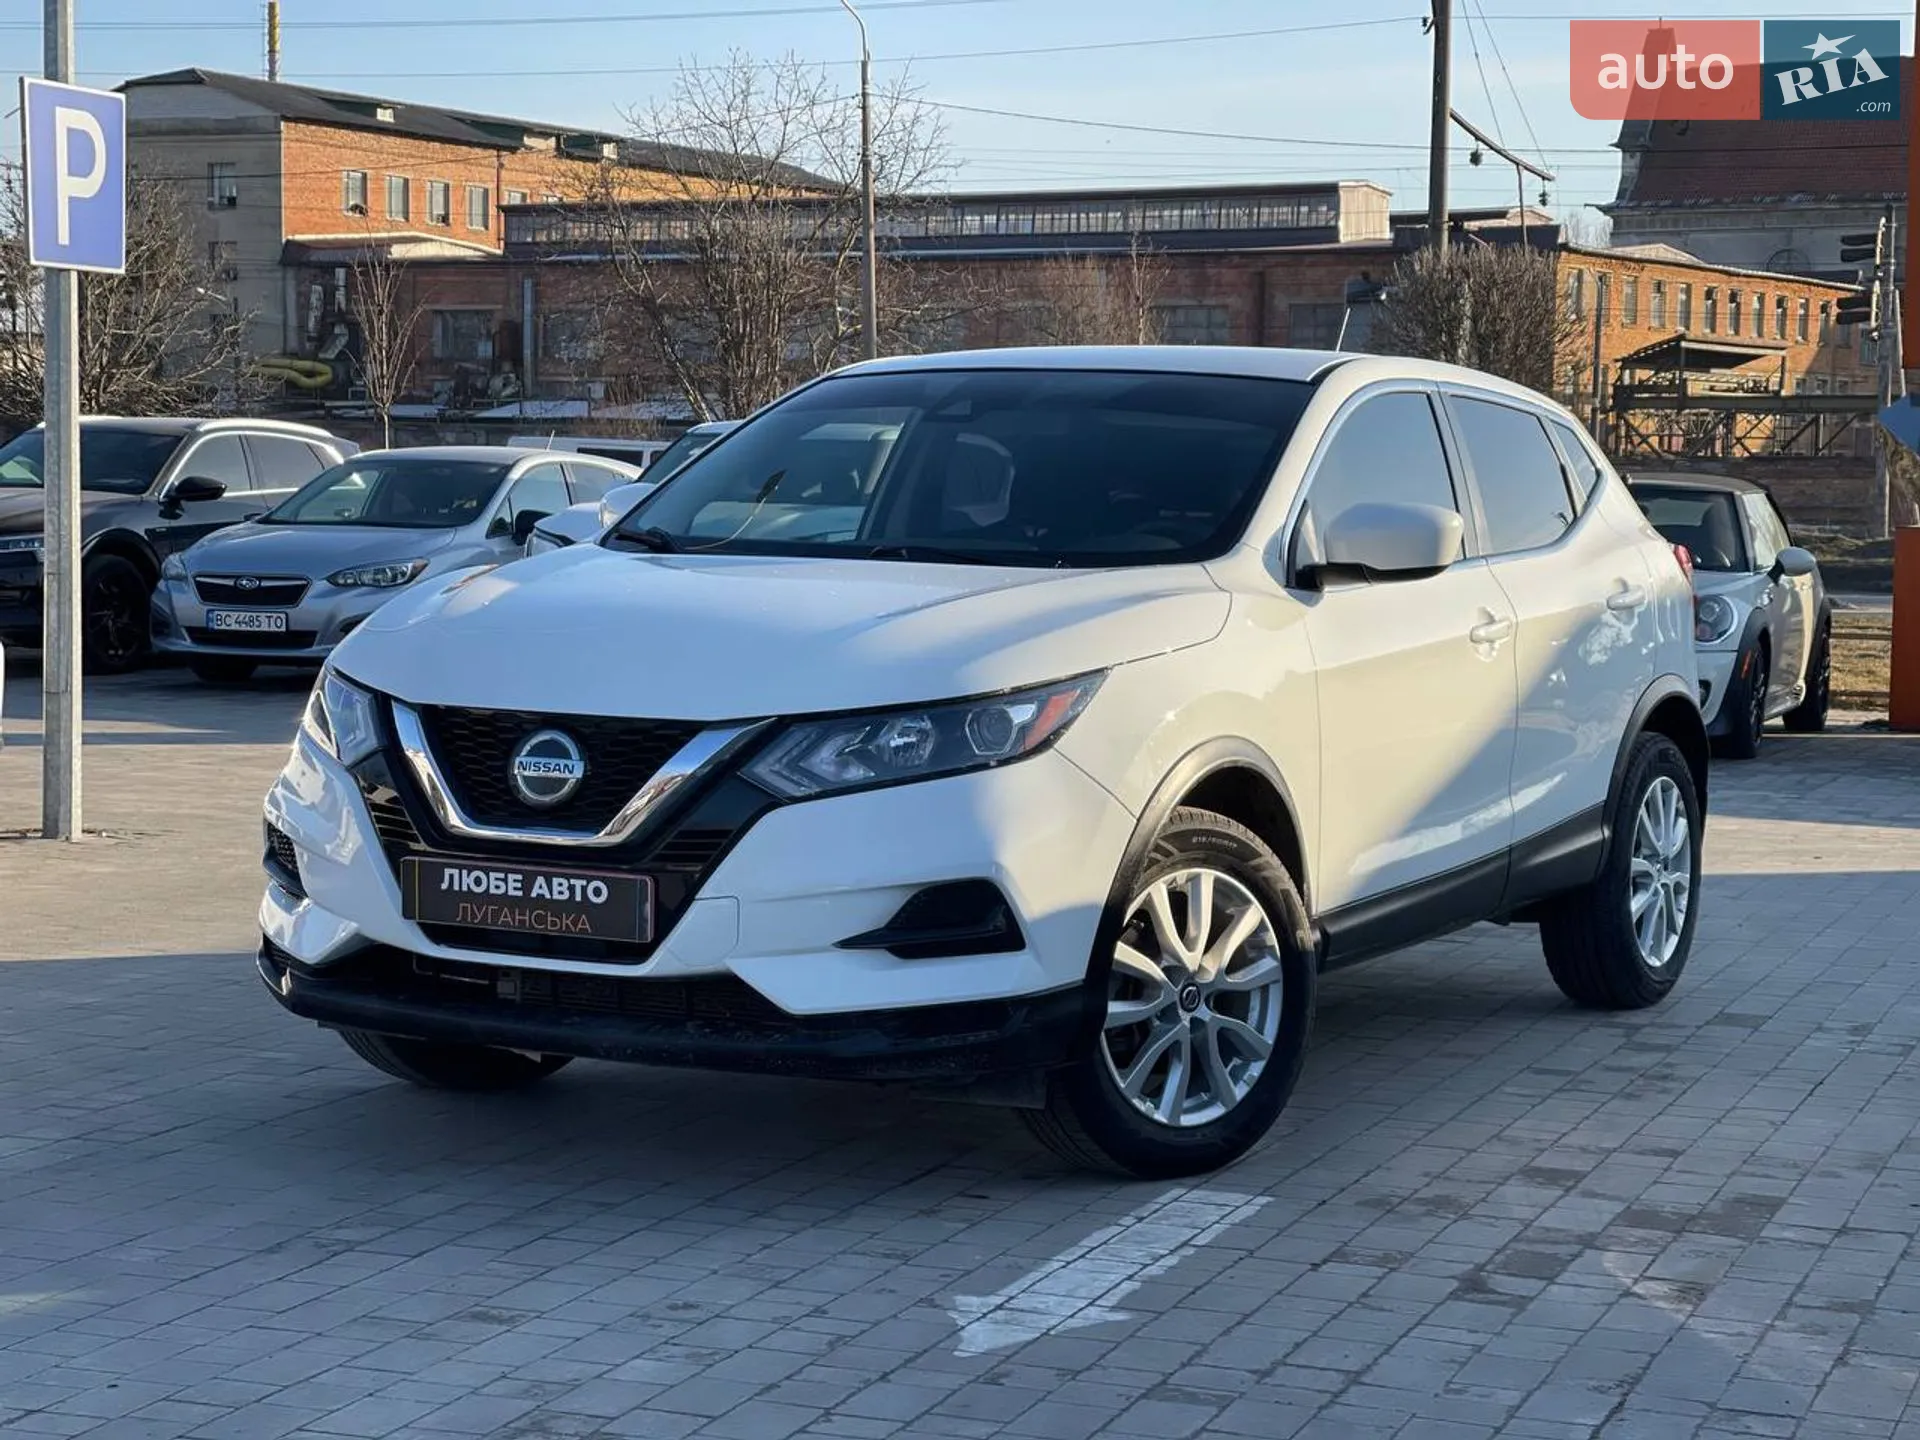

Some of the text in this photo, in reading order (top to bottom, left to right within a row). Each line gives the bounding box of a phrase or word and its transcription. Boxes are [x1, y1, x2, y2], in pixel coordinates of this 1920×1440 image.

[55, 106, 106, 246] P
[215, 613, 283, 629] BC 4485 TO
[517, 761, 575, 774] NISSAN
[440, 867, 609, 904] ЛЮБЕ АВТО
[455, 903, 592, 933] ЛУГАНСЬКА
